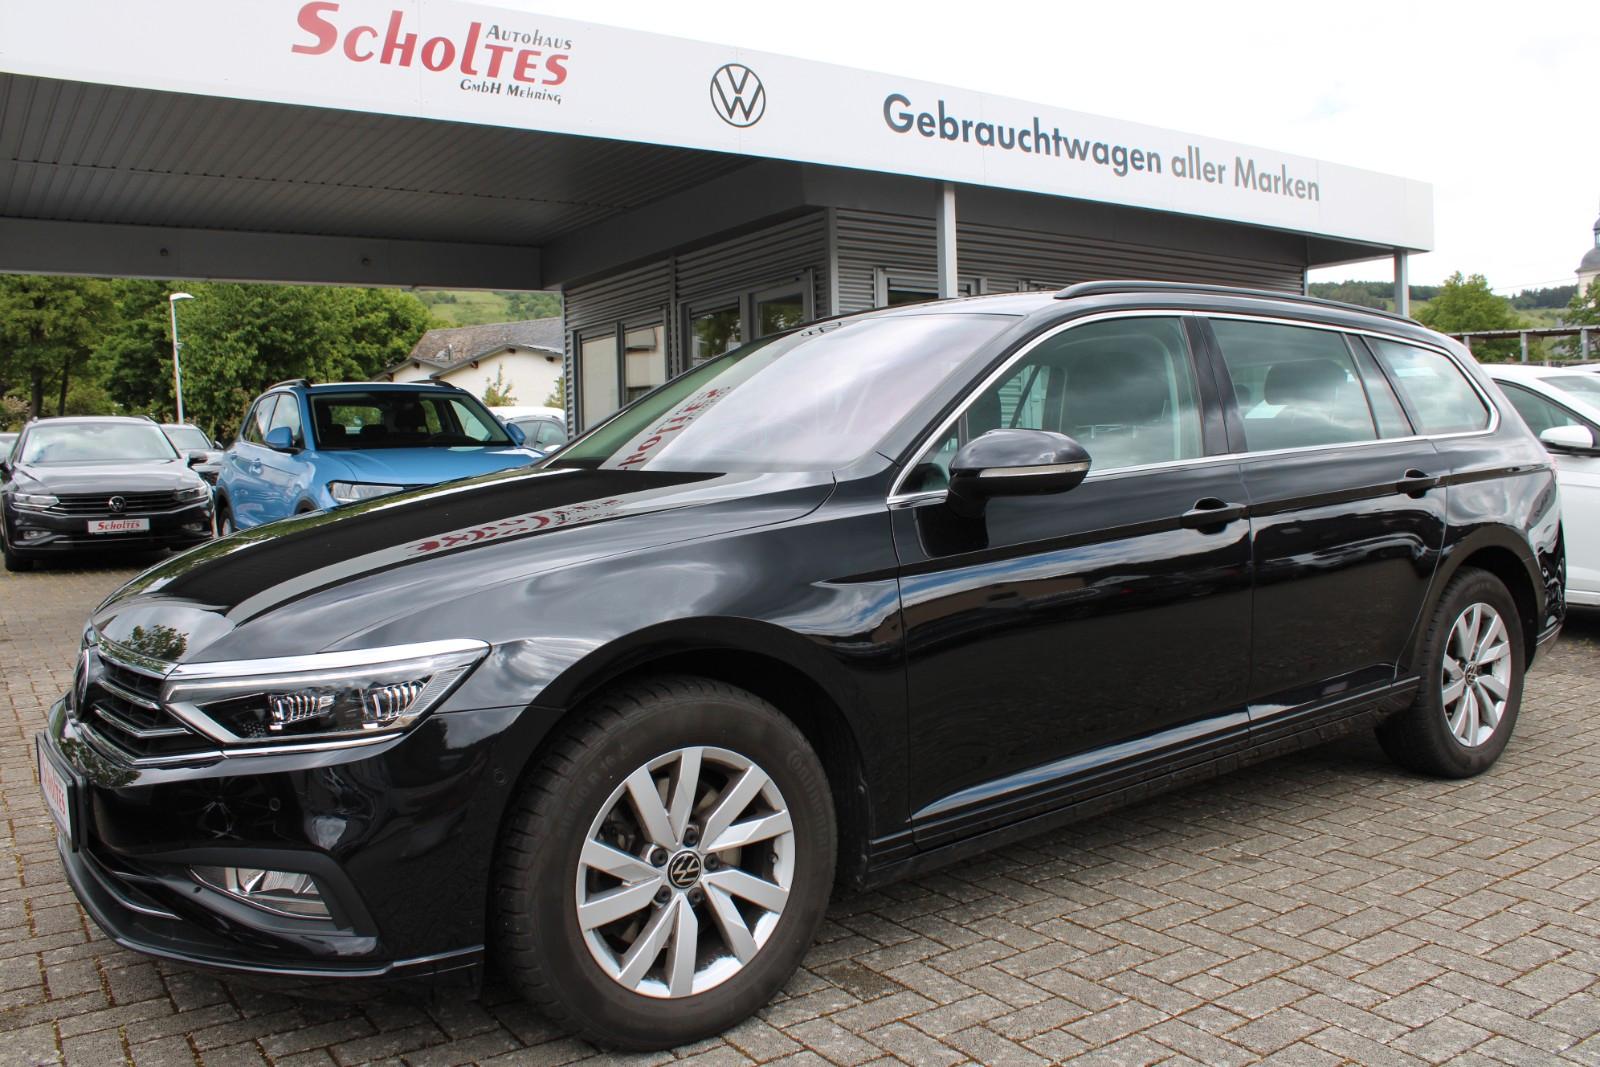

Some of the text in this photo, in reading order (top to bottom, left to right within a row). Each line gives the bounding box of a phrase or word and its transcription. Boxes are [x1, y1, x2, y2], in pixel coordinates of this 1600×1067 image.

[882, 93, 1321, 202] Gebrauchtwagen aller Marken
